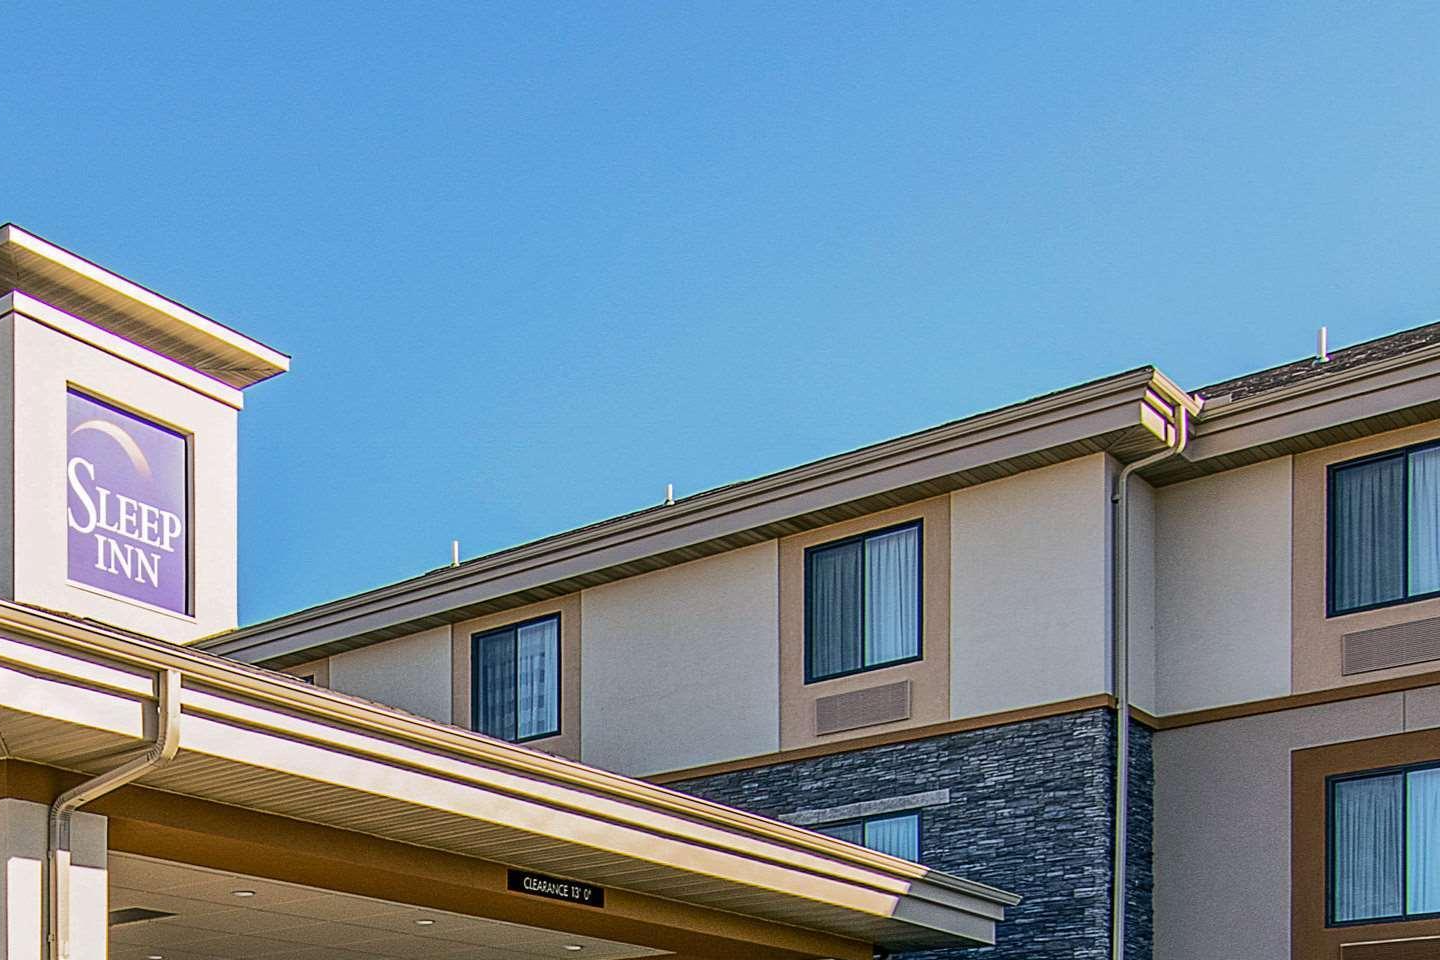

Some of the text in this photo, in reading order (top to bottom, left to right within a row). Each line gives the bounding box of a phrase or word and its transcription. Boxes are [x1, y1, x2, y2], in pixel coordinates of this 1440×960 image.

[67, 457, 182, 553] SLEEP
[94, 534, 161, 588] INN
[523, 877, 569, 897] CLEARANCE
